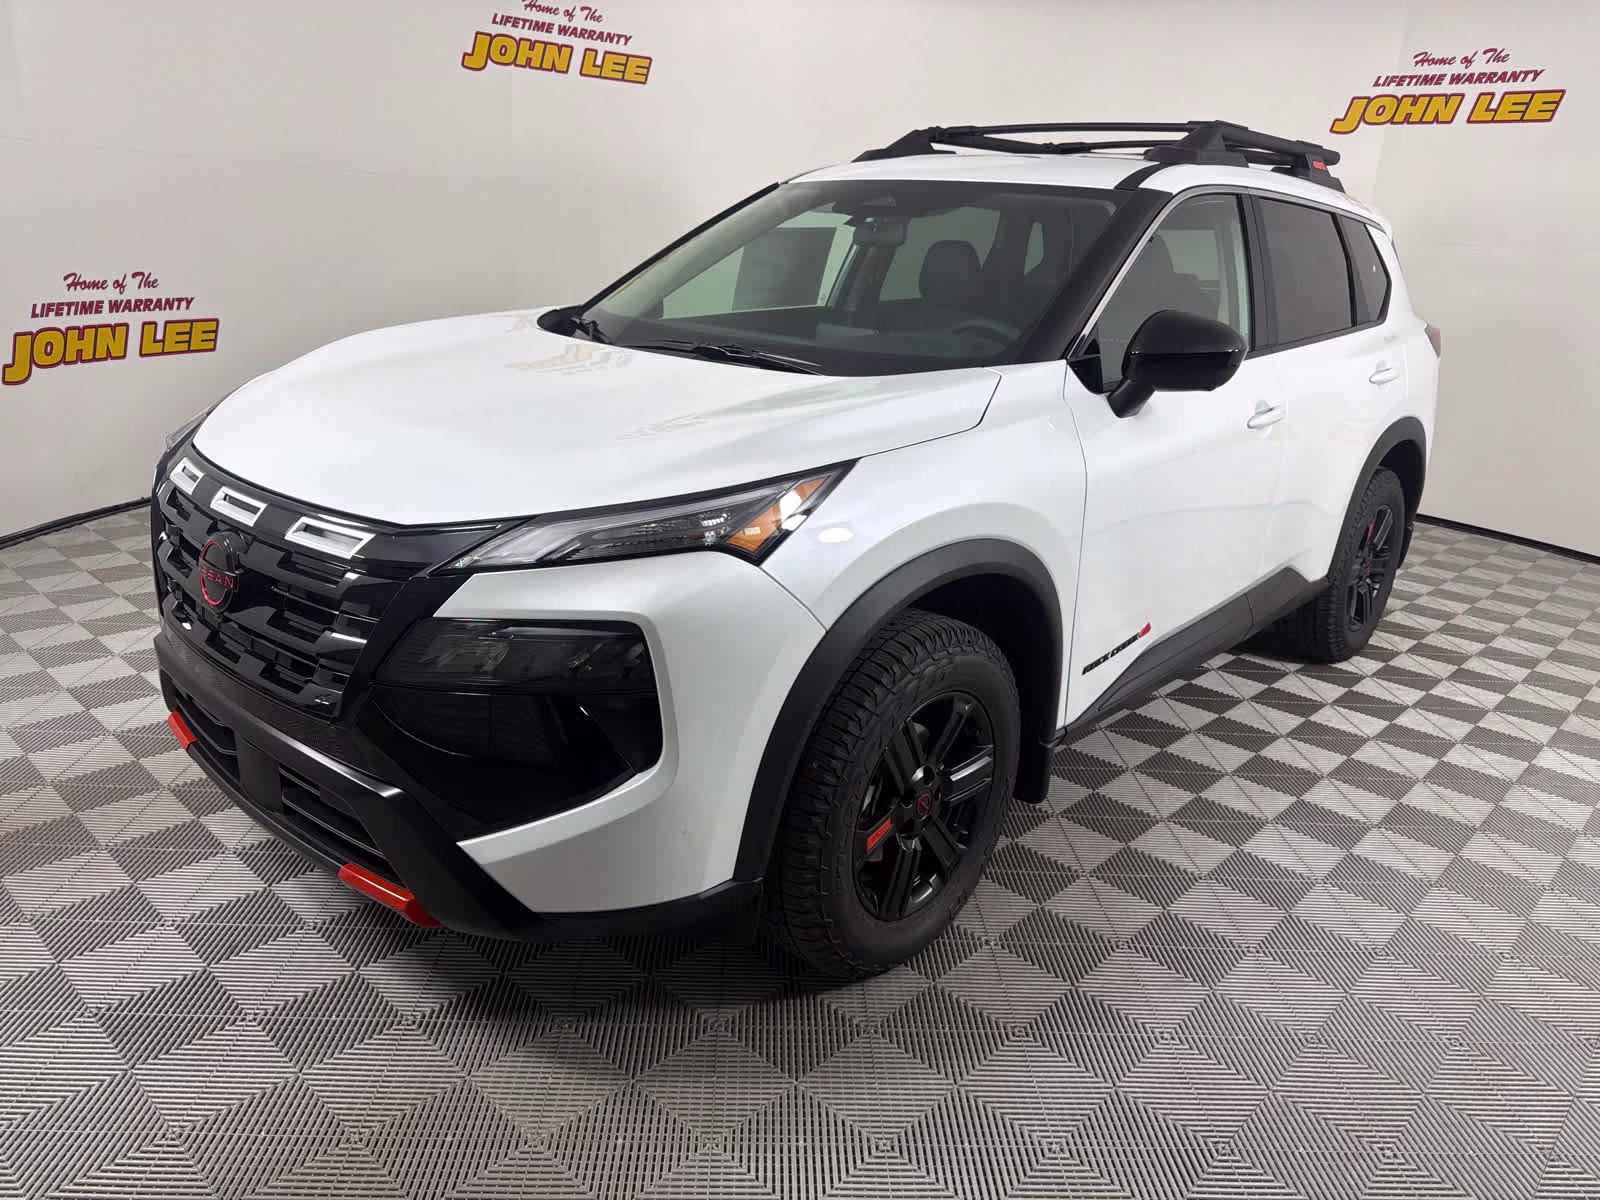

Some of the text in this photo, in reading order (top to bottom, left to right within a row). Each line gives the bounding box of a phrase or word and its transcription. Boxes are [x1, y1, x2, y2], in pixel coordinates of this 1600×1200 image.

[521, 0, 603, 23] Home of The
[492, 13, 632, 46] LIFETIME WARRANTY
[461, 31, 652, 84] JOHN LEE
[1412, 48, 1510, 69] Home of The
[1372, 69, 1545, 88] LIFETIME WARRANTY
[1329, 89, 1566, 135] JOHN LEE
[63, 271, 159, 295] Home of The
[30, 297, 195, 318] LIFETIME WARRANTY
[2, 318, 219, 385] JOHN LEE
